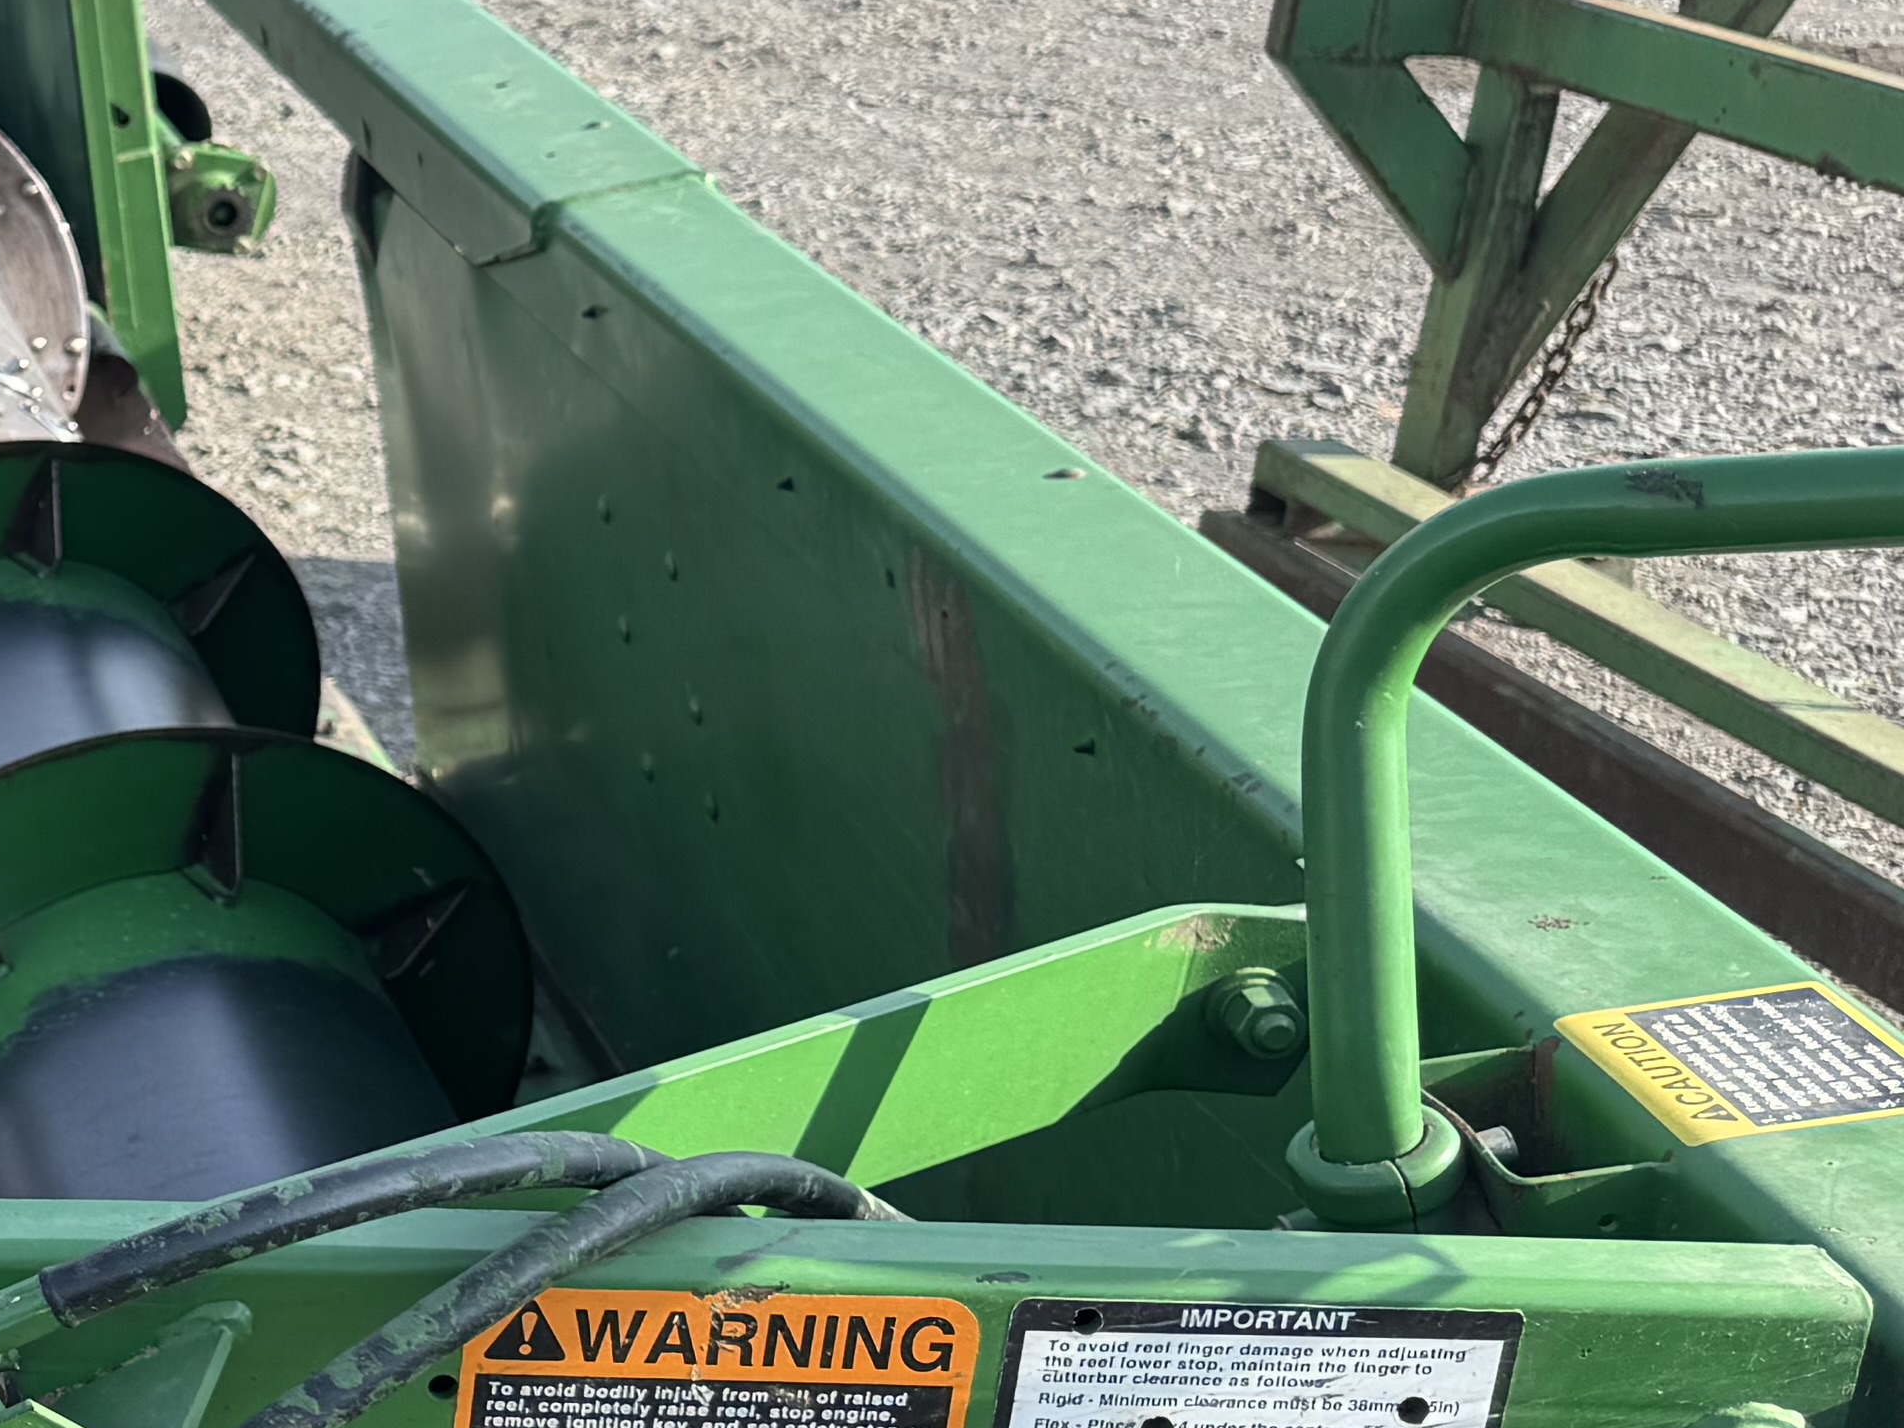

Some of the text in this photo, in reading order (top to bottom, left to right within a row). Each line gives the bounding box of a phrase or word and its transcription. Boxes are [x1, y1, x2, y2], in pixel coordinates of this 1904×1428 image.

[1593, 1021, 1715, 1106] CAUTION
[1180, 1309, 1356, 1332] IMPORTANT
[575, 1308, 956, 1373] WARNING
[1049, 1340, 1466, 1362] To avoid reel finger damage when adjusting
[1044, 1355, 1433, 1377] the reel lower stop, maintain the finger to
[1041, 1371, 1127, 1385] cutterbar
[1132, 1373, 1222, 1387] clearance
[1228, 1376, 1249, 1387] as
[489, 1381, 514, 1396] To
[520, 1384, 576, 1398] avoid
[583, 1384, 648, 1402] bodily
[722, 1388, 769, 1403] from
[816, 1390, 838, 1404] of
[843, 1391, 909, 1406] raised
[1038, 1392, 1084, 1407] Rigid
[1099, 1393, 1177, 1408] Minimum
[1184, 1395, 1267, 1410] clearance
[1273, 1397, 1316, 1411] must
[1322, 1399, 1343, 1411] be
[484, 1415, 559, 1428] remove
[486, 1399, 897, 1424] reel, completely raise reel, stop engine,
